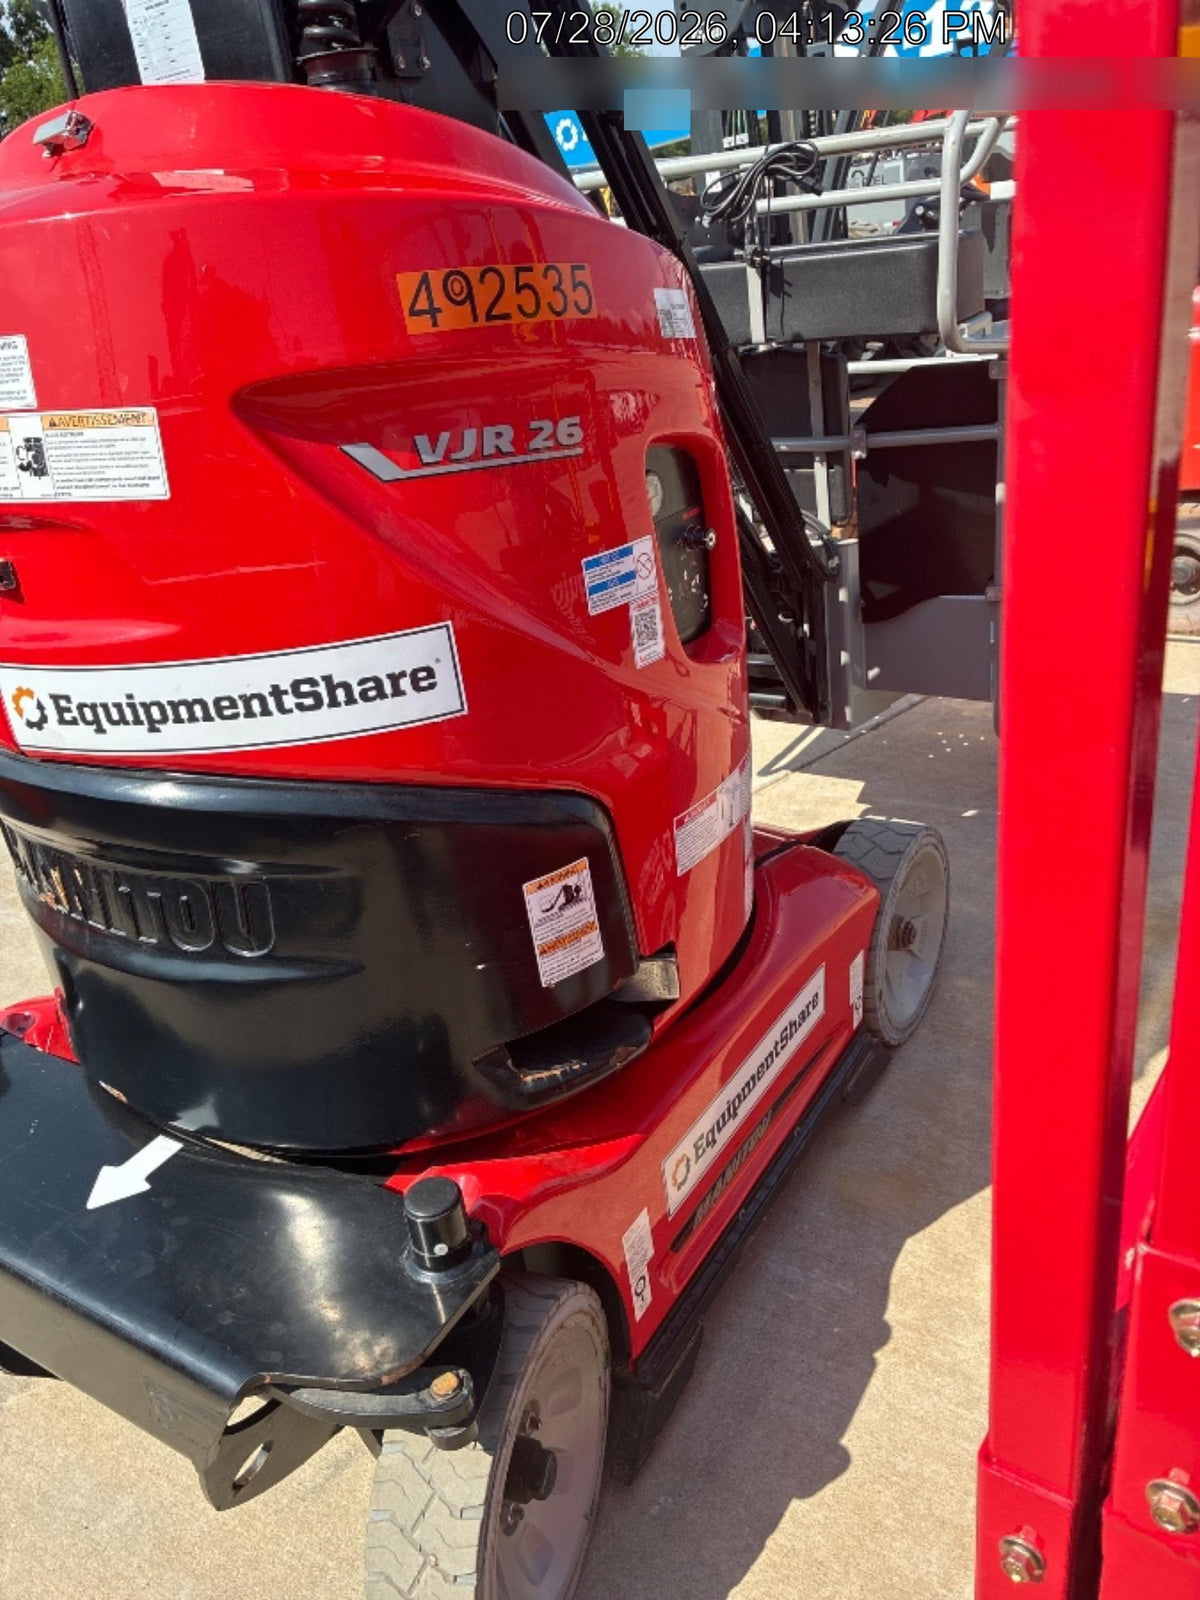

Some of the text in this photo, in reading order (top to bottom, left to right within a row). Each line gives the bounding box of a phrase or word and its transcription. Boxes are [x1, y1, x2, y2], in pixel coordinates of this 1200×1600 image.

[408, 264, 593, 327] 492535
[413, 415, 584, 465] VJR 26
[48, 664, 438, 734] EquipmentShare
[692, 991, 820, 1166] EquipmentShare
